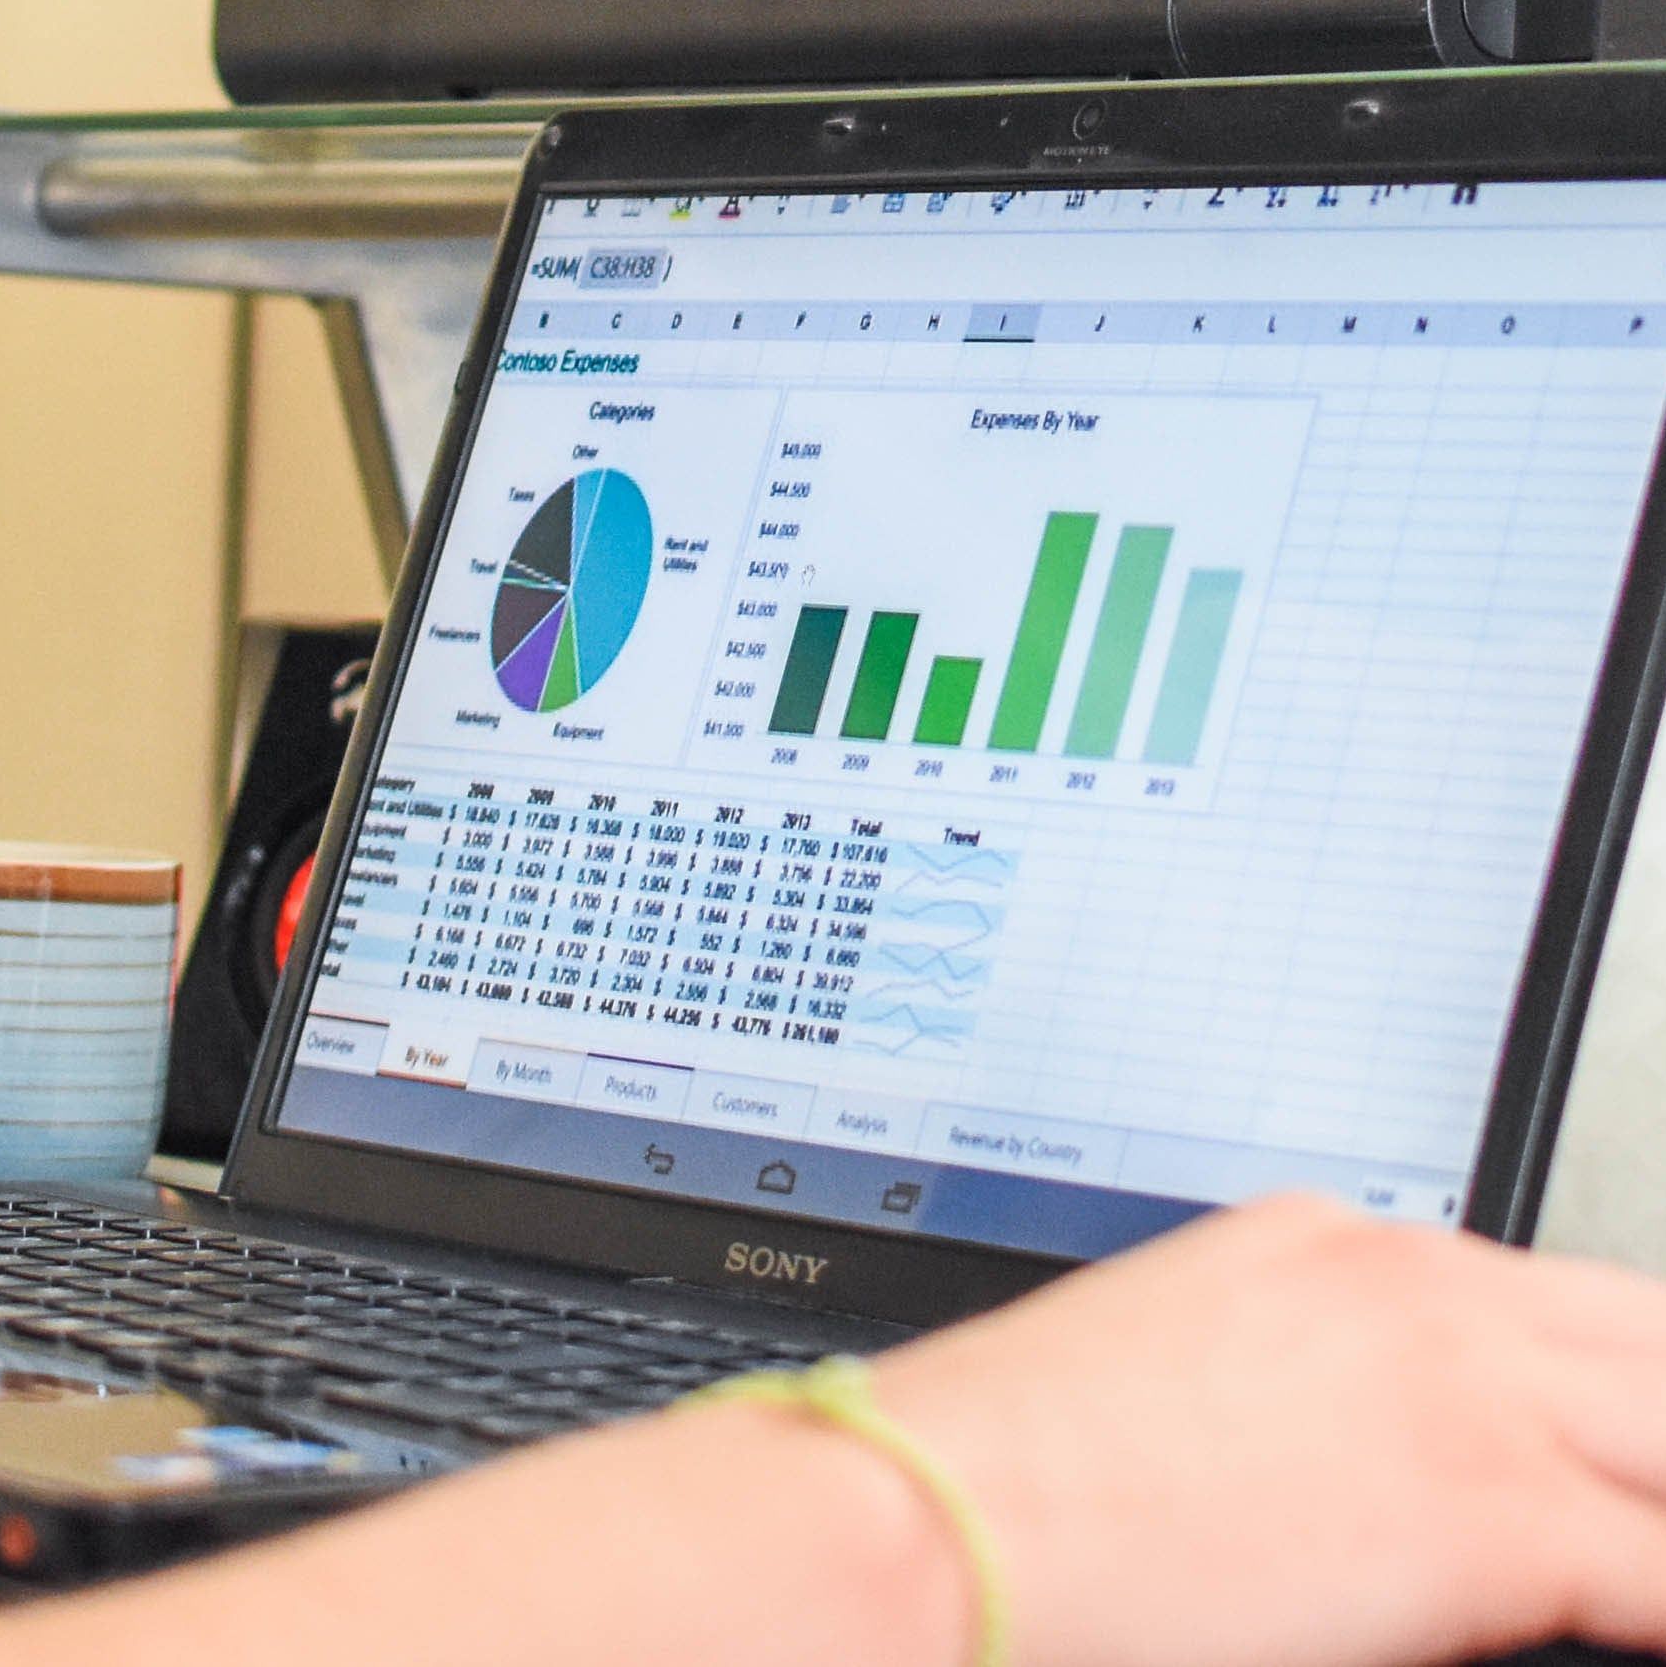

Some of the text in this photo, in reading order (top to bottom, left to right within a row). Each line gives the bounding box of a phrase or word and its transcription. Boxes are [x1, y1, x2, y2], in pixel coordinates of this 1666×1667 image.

[559, 349, 640, 376] Expenses
[589, 400, 656, 425] Categories
[970, 408, 1101, 435] Expenses By Year
[943, 826, 981, 847] Trend
[712, 1091, 778, 1119] Customers
[724, 1240, 829, 1286] SONY
